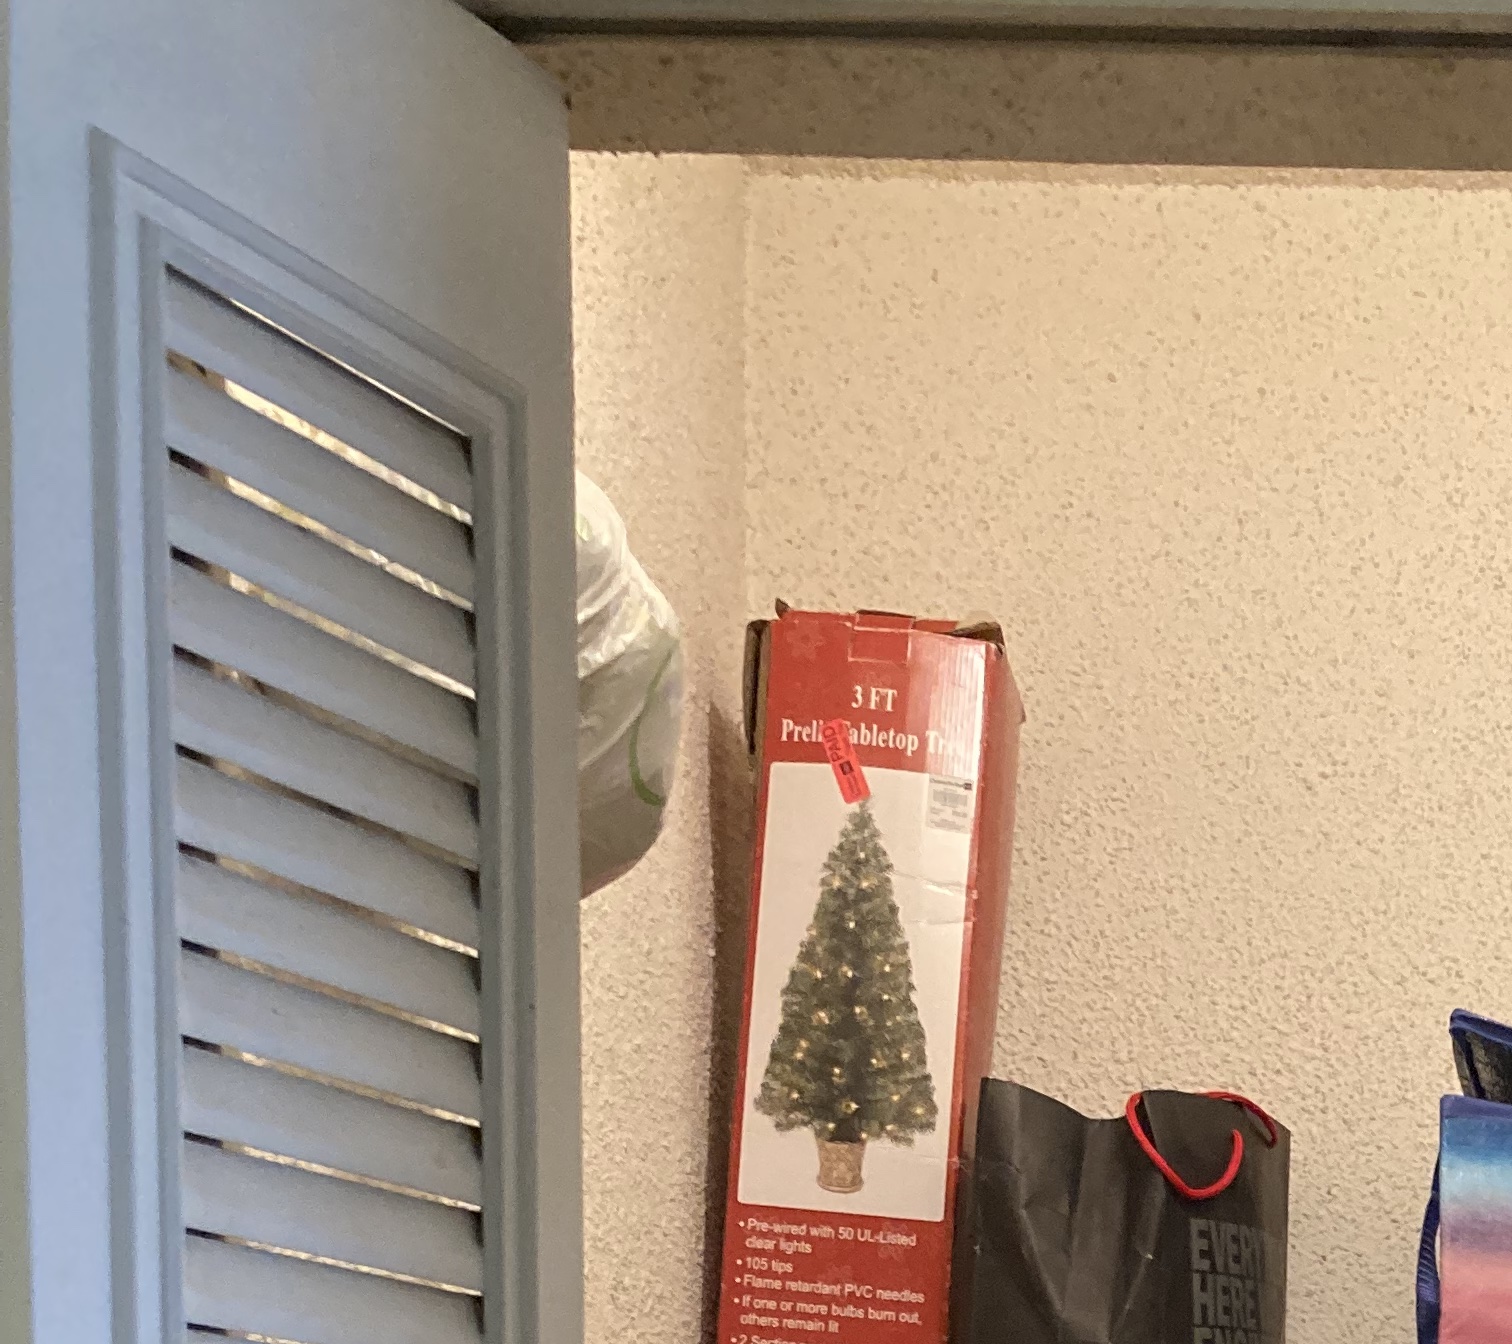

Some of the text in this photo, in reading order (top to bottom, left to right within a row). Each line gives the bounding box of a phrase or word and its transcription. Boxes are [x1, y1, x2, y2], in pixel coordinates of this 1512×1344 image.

[851, 685, 898, 712] 3 FT
[780, 718, 826, 744] Preli
[745, 1236, 812, 1254] clear lights
[747, 1218, 917, 1247] Pre-wired with 50 UL-Listed
[746, 1256, 793, 1274] 105 tips
[743, 1275, 925, 1303] Flame retardant PVC needles
[1192, 1272, 1260, 1331] HERE
[742, 1295, 751, 1307] If
[753, 1298, 777, 1310] one
[780, 1301, 794, 1311] or
[796, 1302, 829, 1315] more
[831, 1304, 865, 1319] bulbs
[868, 1307, 896, 1322] burn
[740, 1313, 839, 1333] others remain lit
